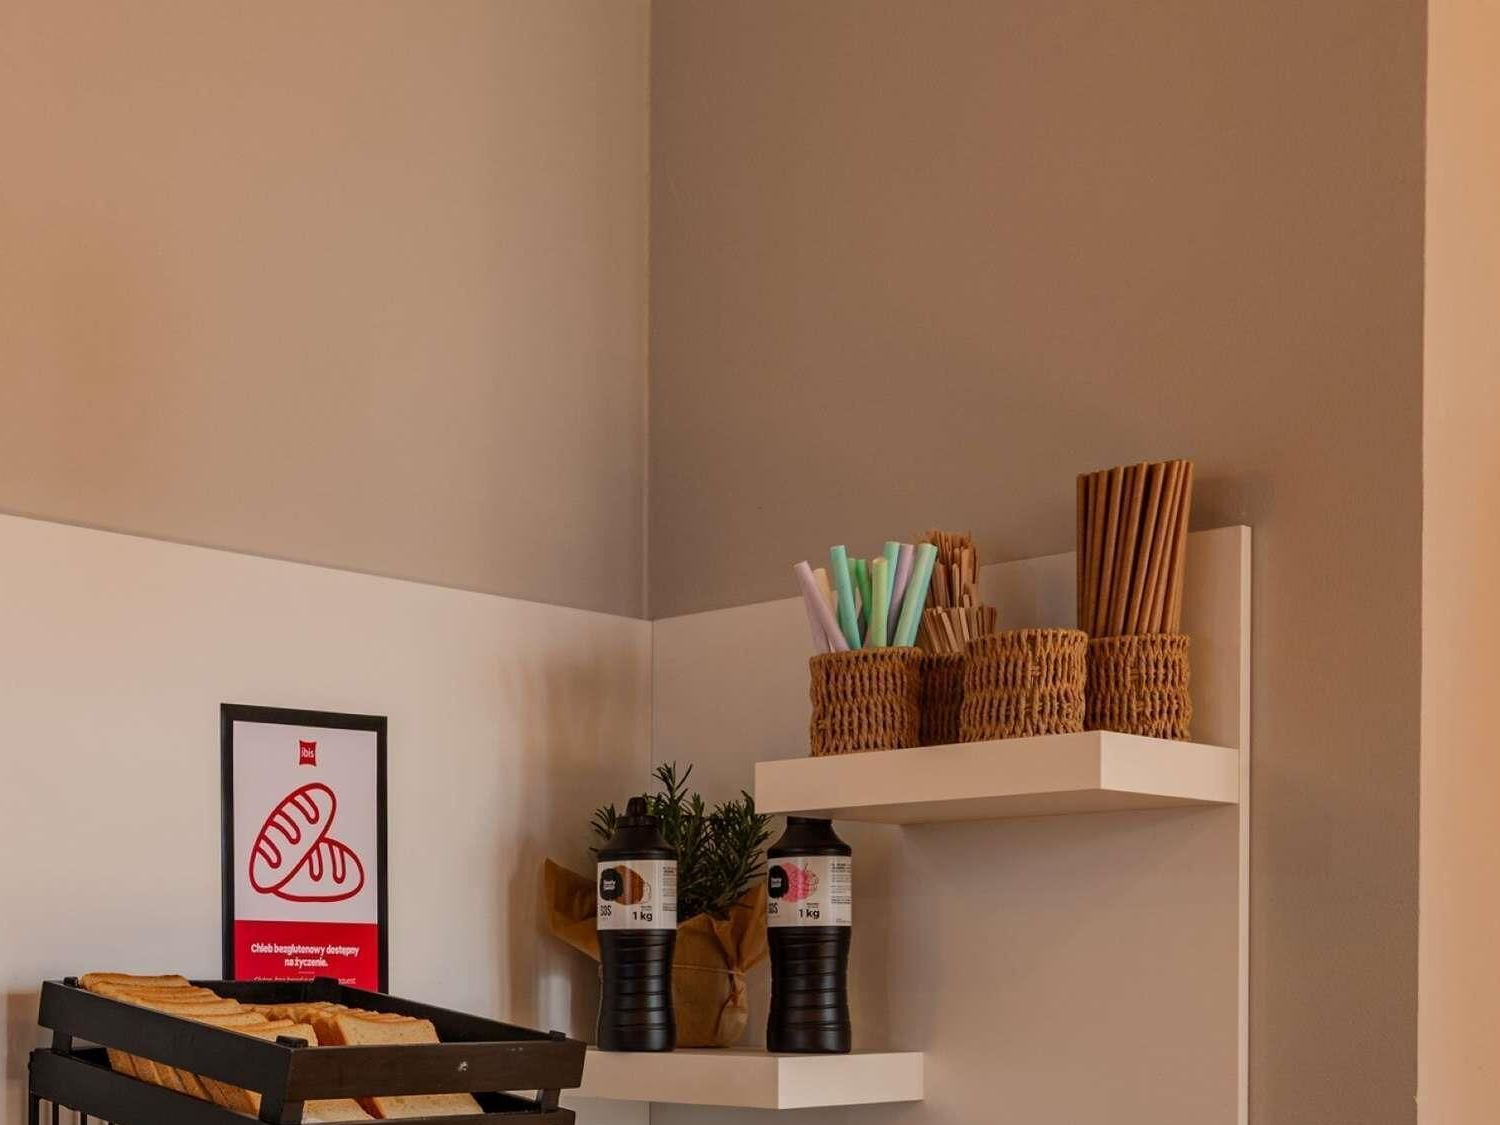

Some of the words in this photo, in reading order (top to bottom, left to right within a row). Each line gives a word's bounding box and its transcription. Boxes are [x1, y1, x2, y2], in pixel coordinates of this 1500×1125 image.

[301, 747, 315, 758] ibis
[632, 912, 638, 921] 1
[640, 911, 653, 922] kg
[799, 909, 804, 918] 1
[806, 909, 820, 920] kg
[251, 942, 274, 953] Chleb
[274, 943, 325, 956] bezglutenowy
[284, 958, 293, 967] na
